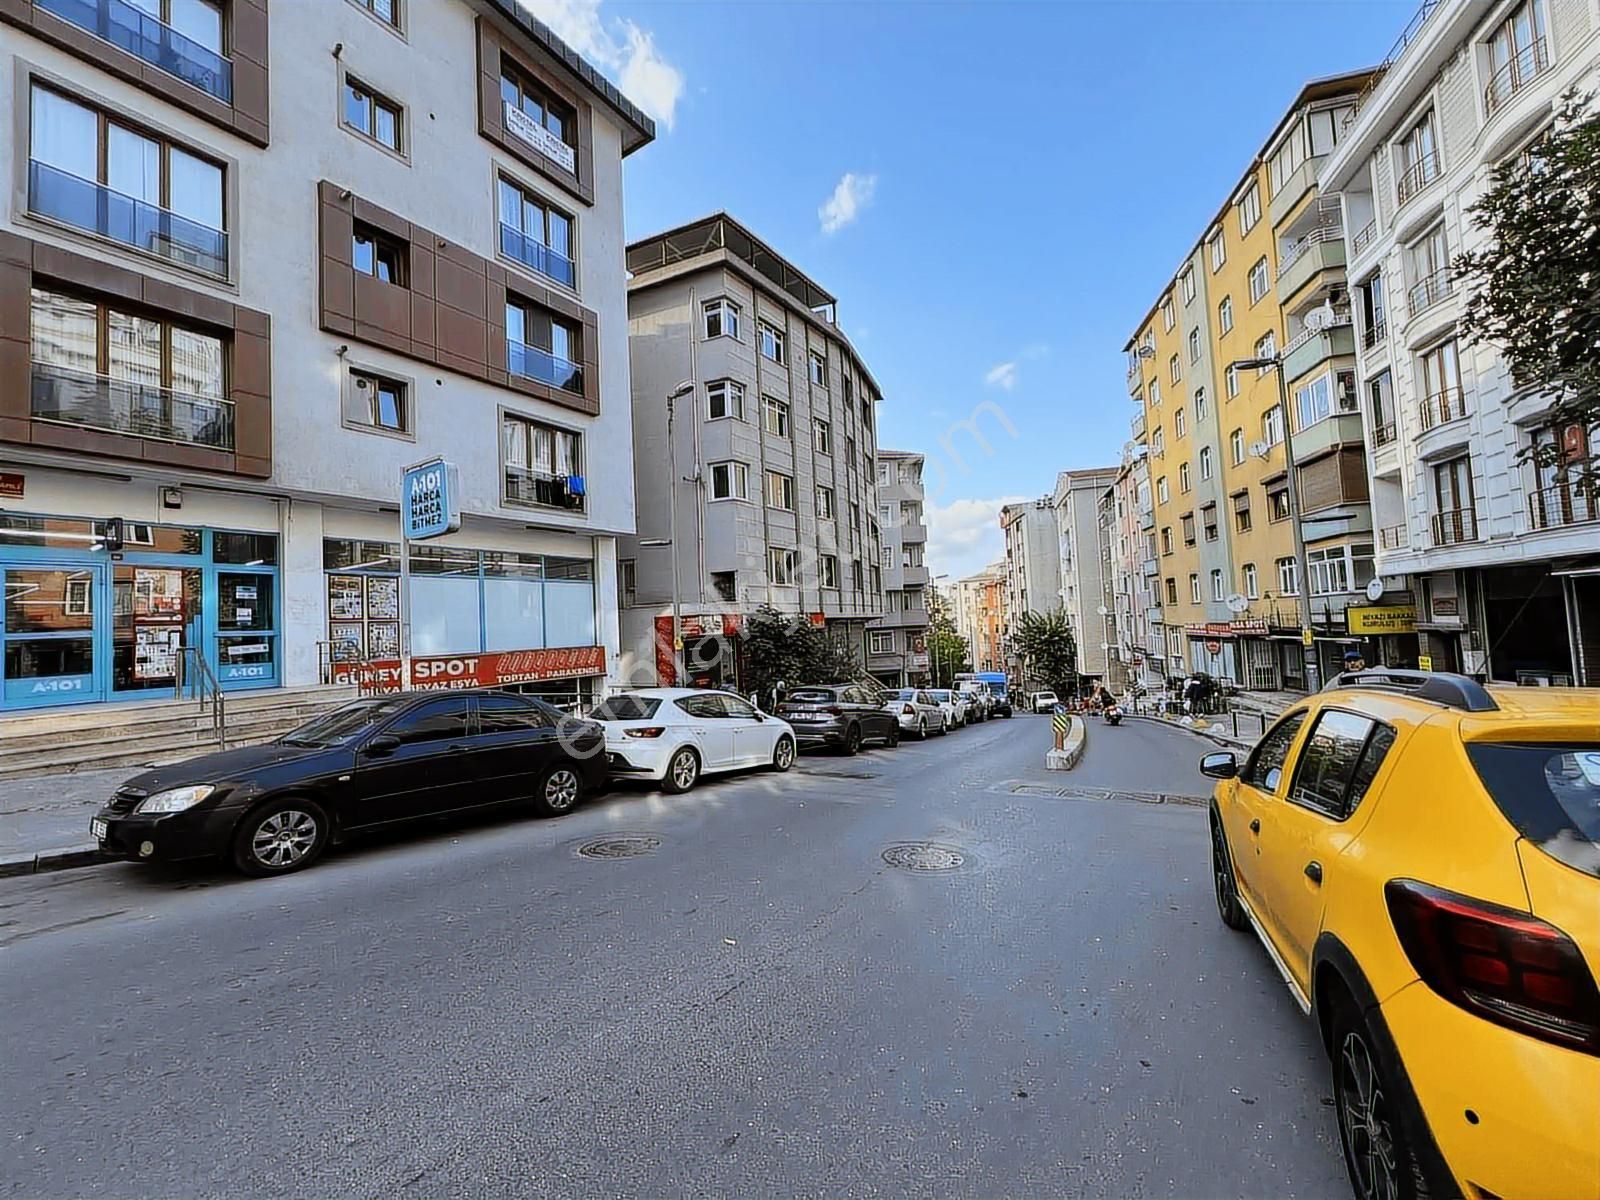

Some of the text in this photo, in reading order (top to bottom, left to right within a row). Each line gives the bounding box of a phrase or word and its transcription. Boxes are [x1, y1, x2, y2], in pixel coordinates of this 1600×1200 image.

[411, 488, 441, 506] HARCA
[411, 501, 442, 519] HARCA
[415, 658, 479, 679] SPOT
[496, 671, 539, 684] TOPTAN
[450, 677, 480, 689] EŞYA
